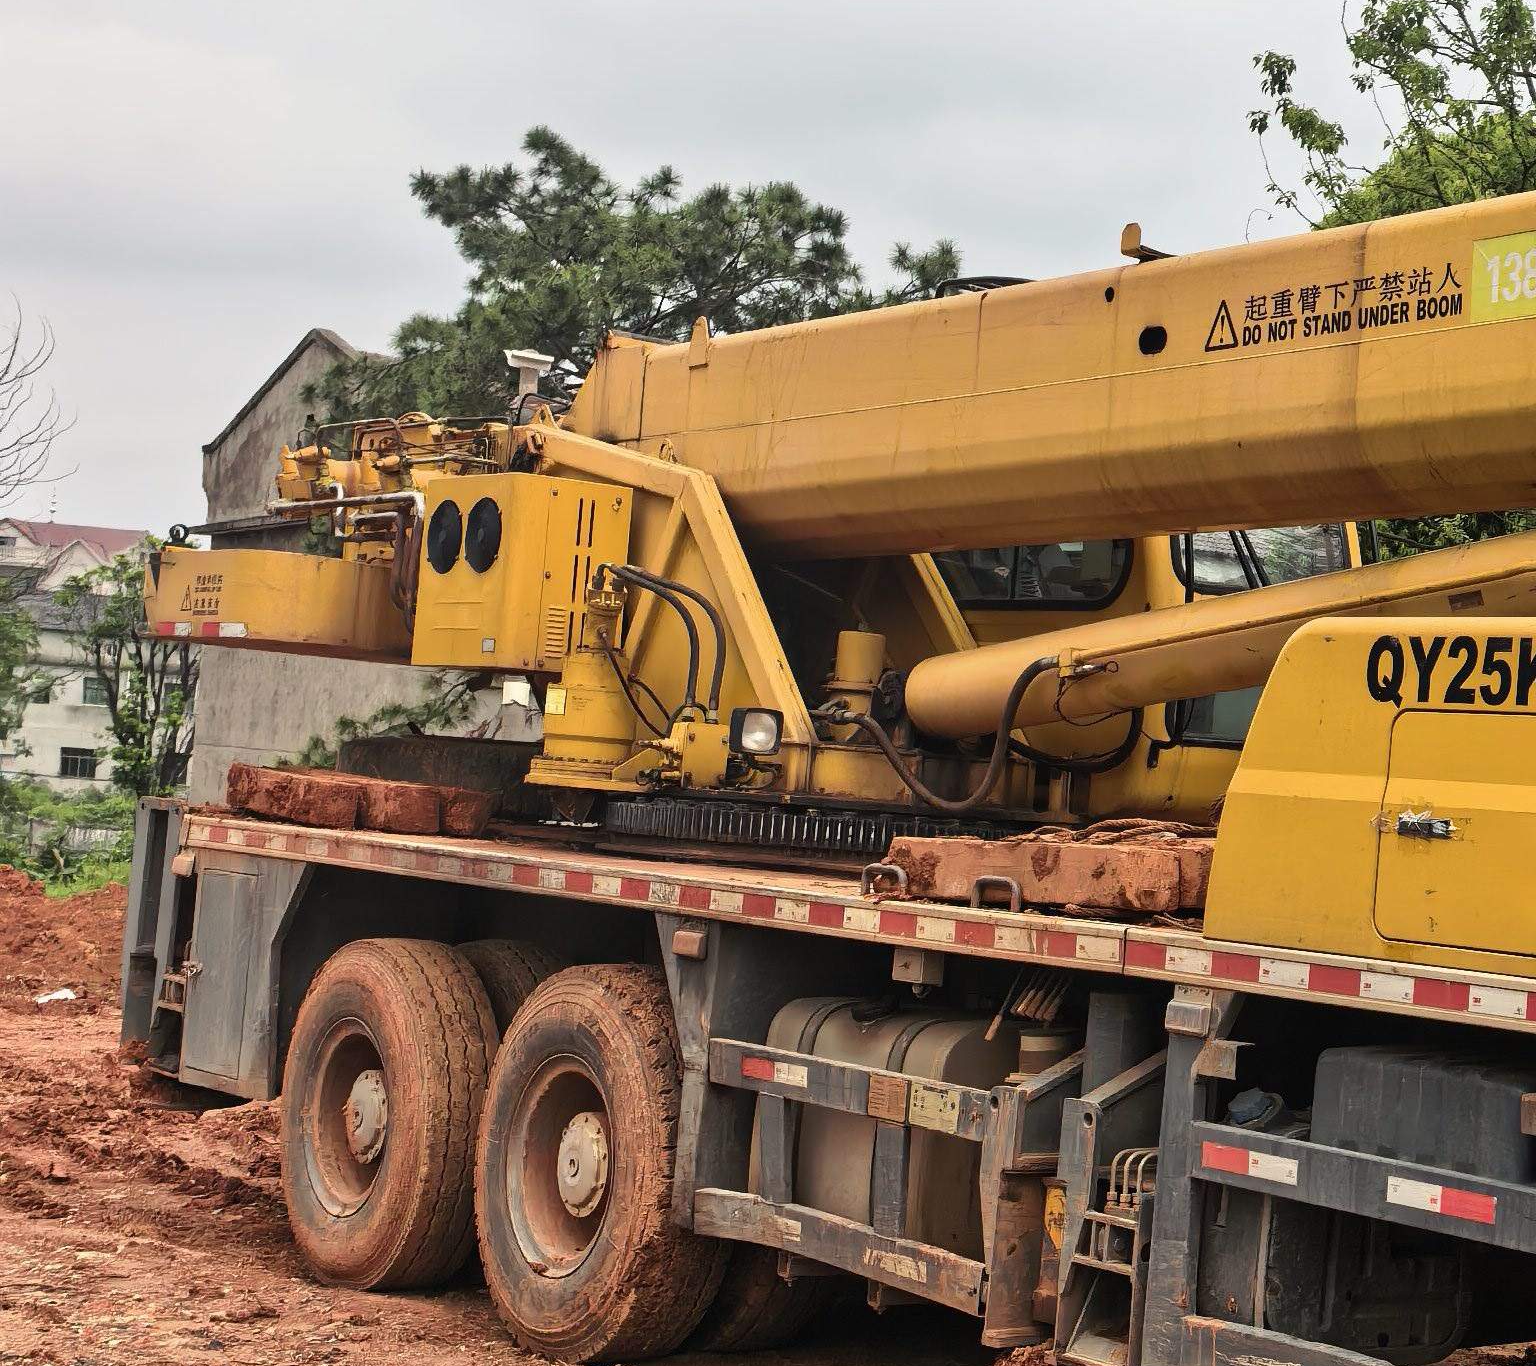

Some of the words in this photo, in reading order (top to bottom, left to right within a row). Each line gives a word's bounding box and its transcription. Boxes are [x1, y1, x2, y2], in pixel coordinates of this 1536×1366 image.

[1242, 323, 1262, 347] DO
[1267, 318, 1298, 343] NOT
[1303, 310, 1352, 338] STAND
[1357, 301, 1410, 330] UNDER
[1416, 292, 1463, 321] BOOM
[1243, 262, 1463, 325] 起重臂下严禁站人
